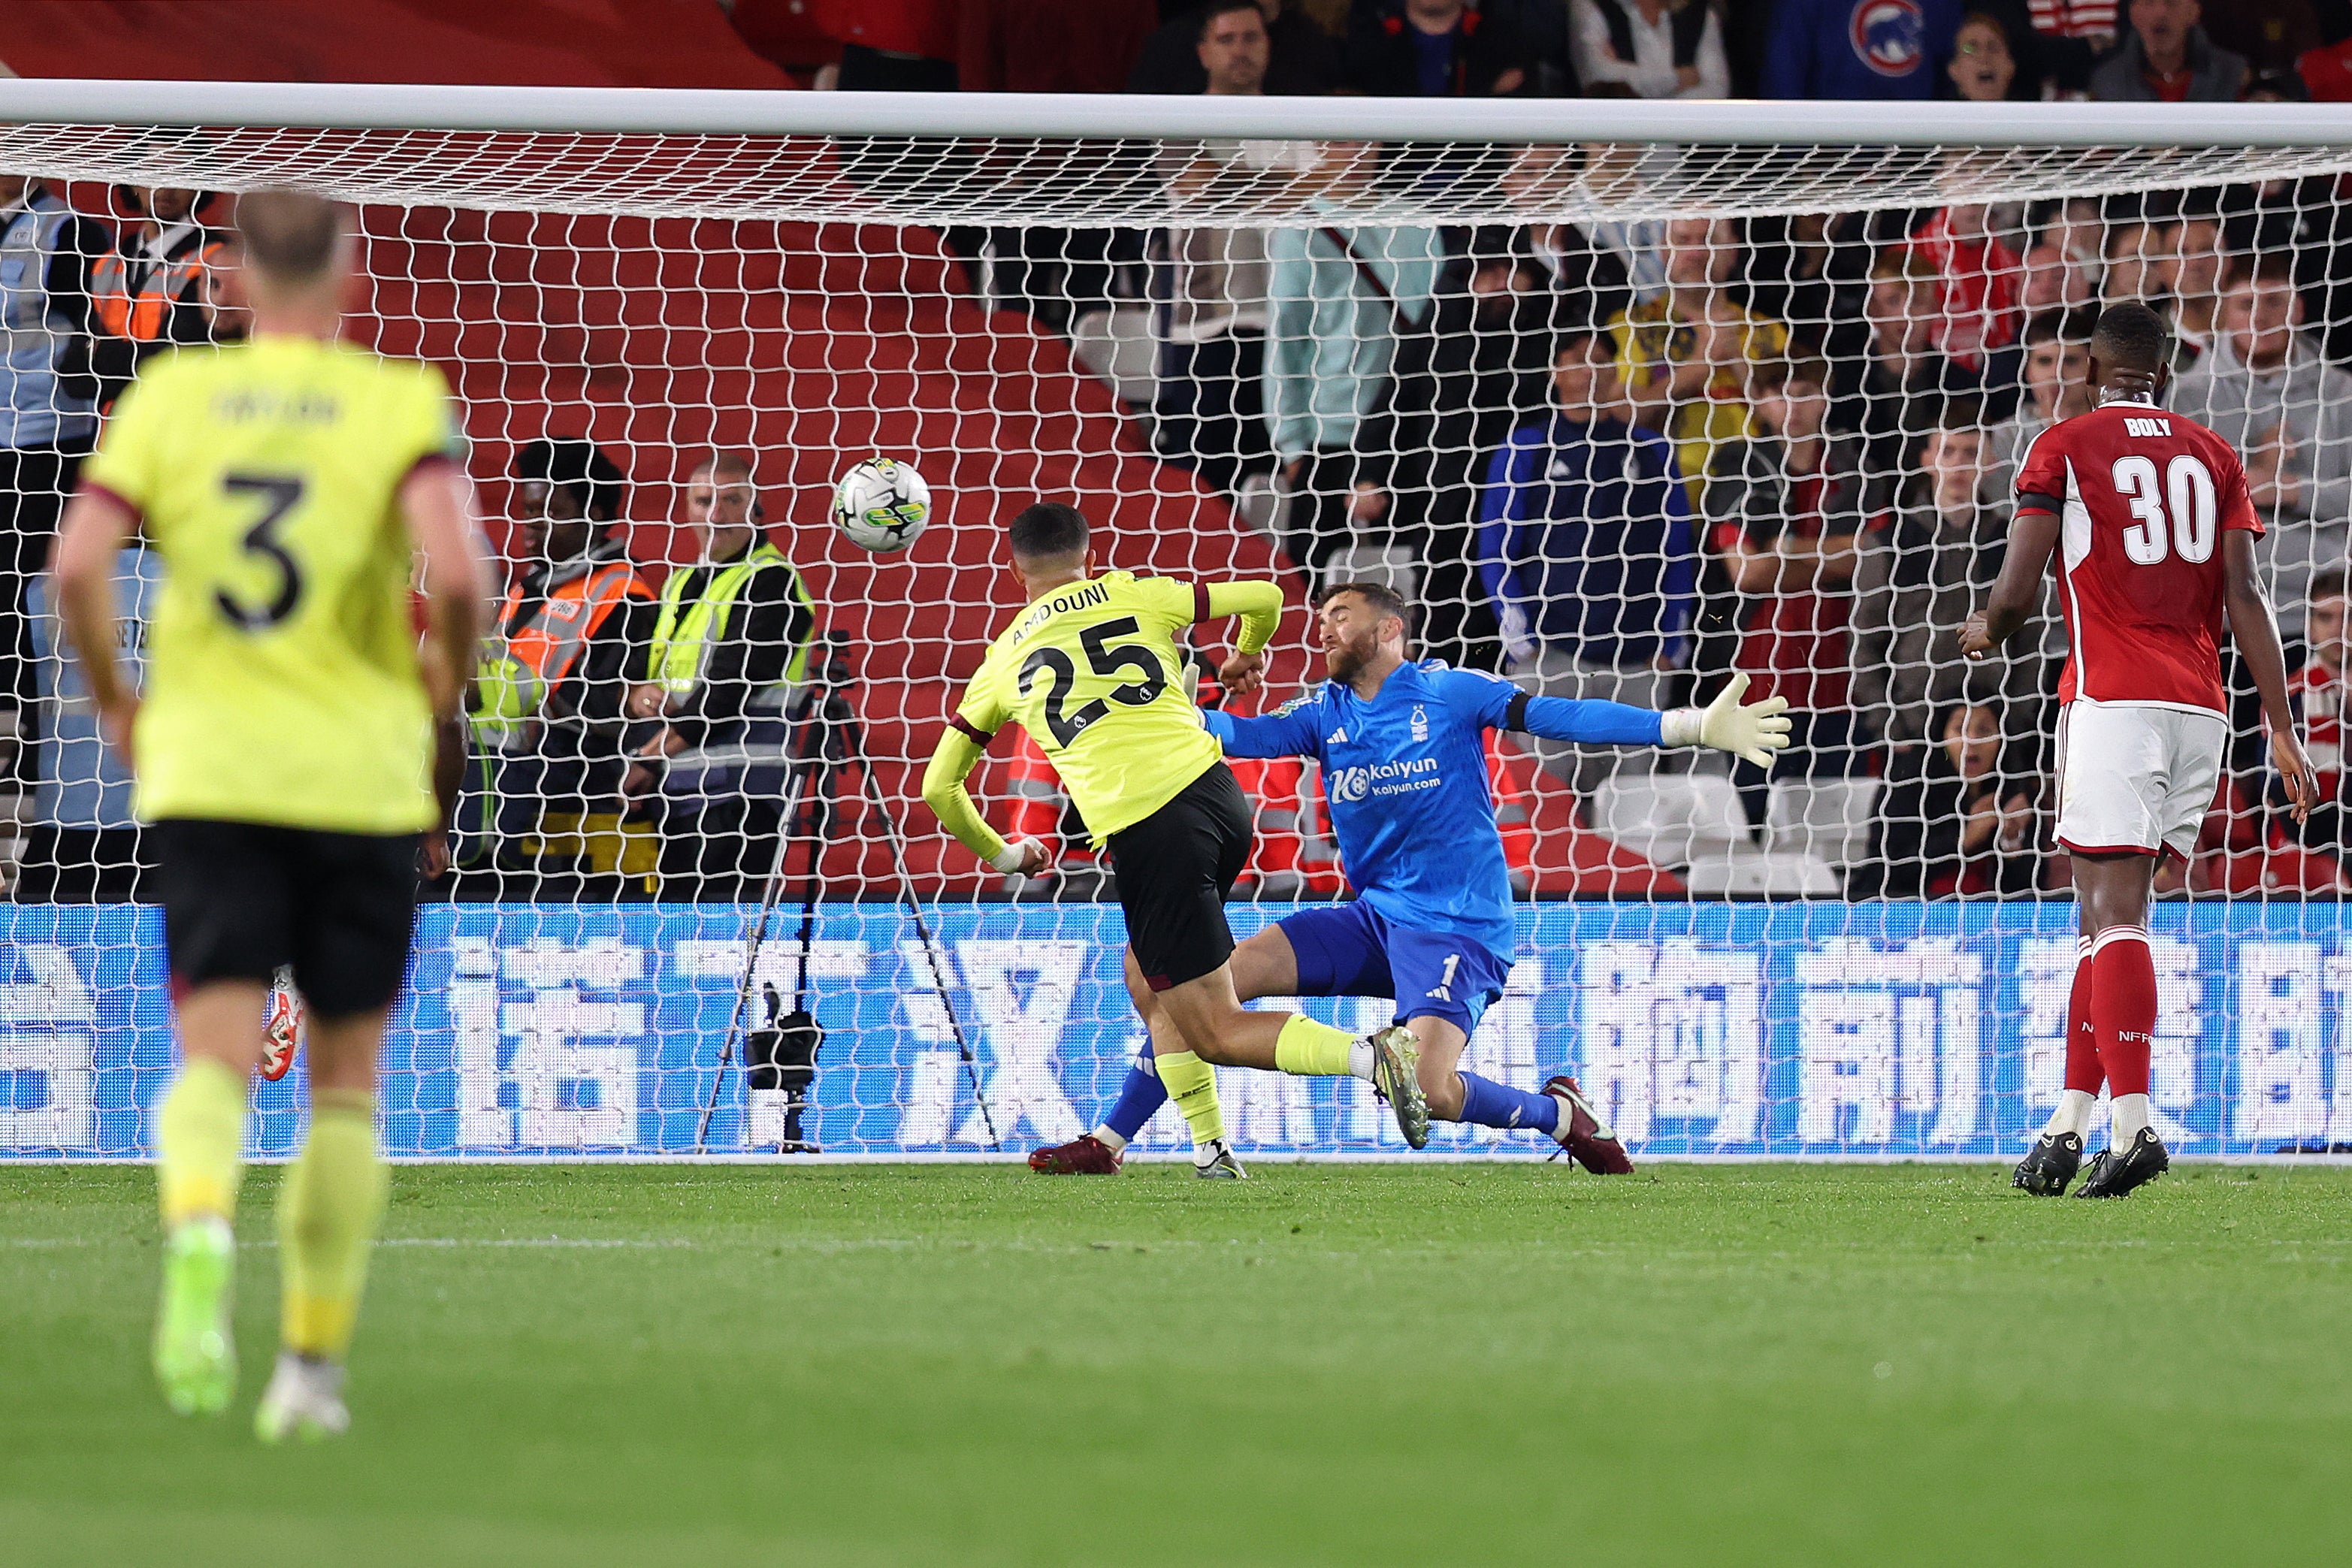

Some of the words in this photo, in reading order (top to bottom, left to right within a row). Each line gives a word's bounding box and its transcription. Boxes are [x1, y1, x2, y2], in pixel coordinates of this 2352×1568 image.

[2124, 418, 2172, 437] BOLY
[2112, 455, 2216, 565] 30
[217, 473, 304, 629] 3
[1013, 582, 1109, 645] AMDOUNI
[1018, 616, 1168, 749] 25
[1369, 757, 1438, 781] kaiyun
[1371, 776, 1441, 797] kaiyun.com
[1441, 953, 1460, 987] 1
